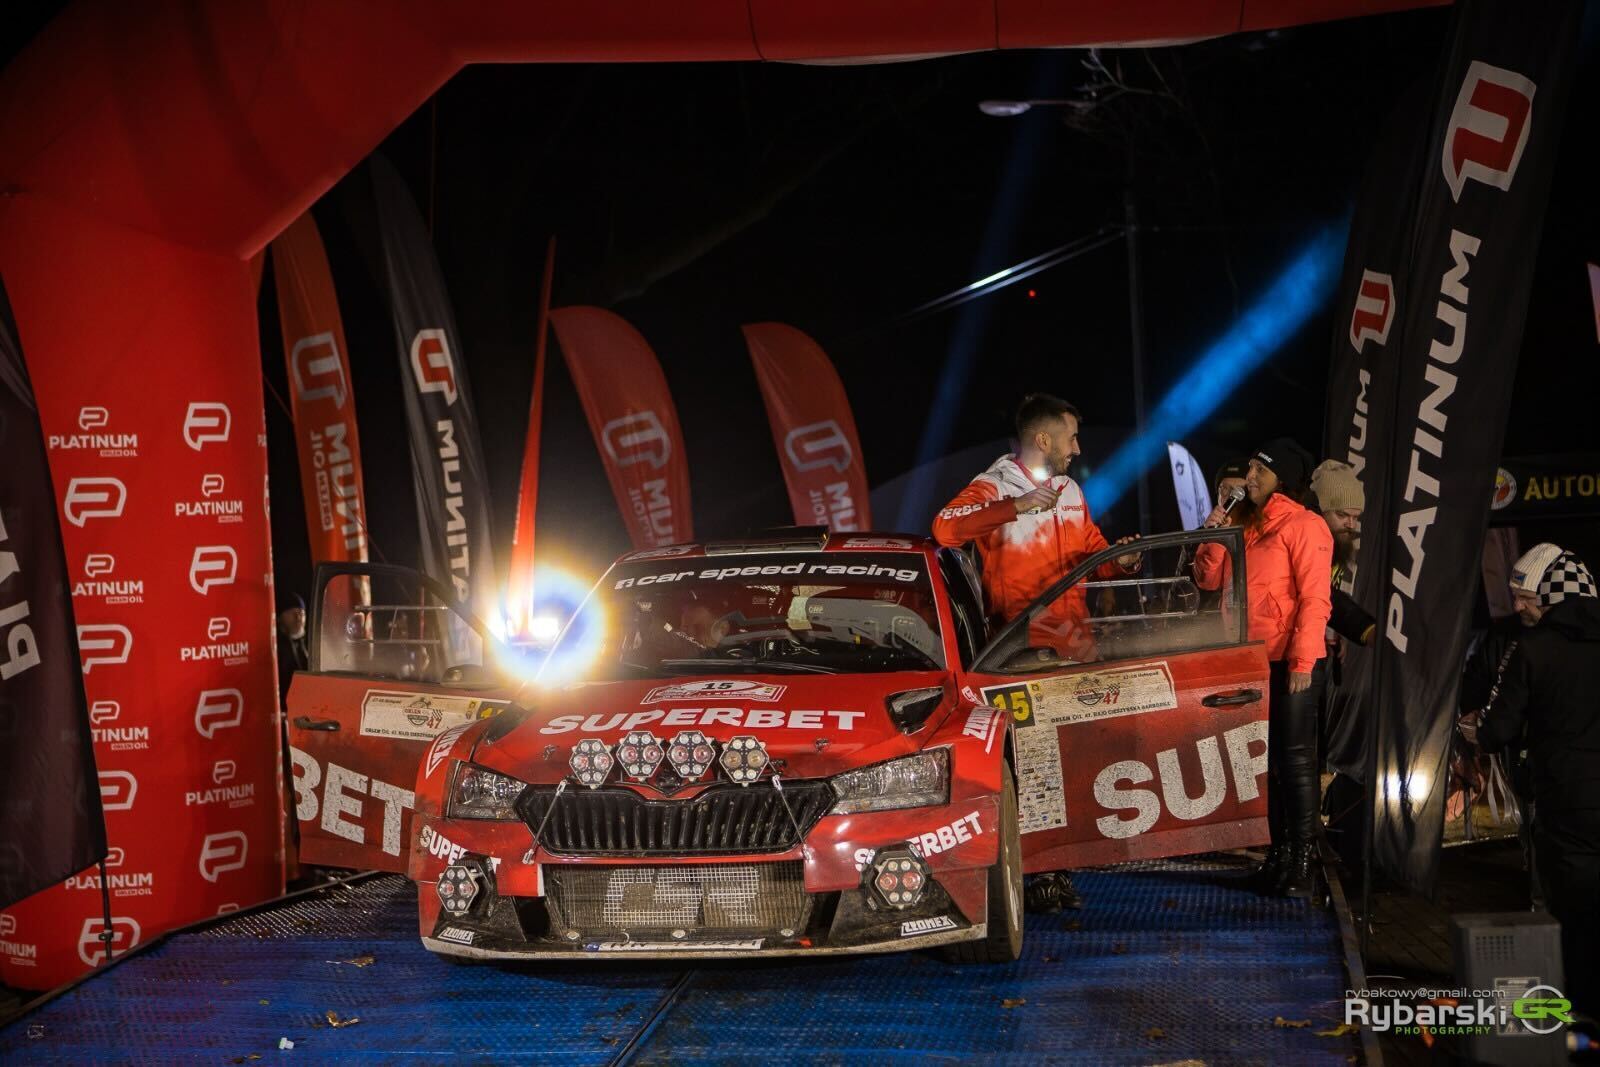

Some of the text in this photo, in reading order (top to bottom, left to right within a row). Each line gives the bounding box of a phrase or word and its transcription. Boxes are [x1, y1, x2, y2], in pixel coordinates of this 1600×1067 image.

[50, 434, 137, 449] PLATINUM
[1385, 229, 1481, 653] PLATINUM
[1524, 473, 1600, 501] AUTO
[175, 500, 243, 517] PLATINUM
[638, 562, 919, 587] car speed racing
[180, 642, 249, 661] PLATINUM
[702, 682, 734, 690] 15
[1102, 690, 1120, 705] 47
[540, 707, 866, 735] SUPERBET
[1093, 719, 1268, 840] SUP
[185, 784, 255, 806] PLATINUM
[290, 745, 416, 857] BET
